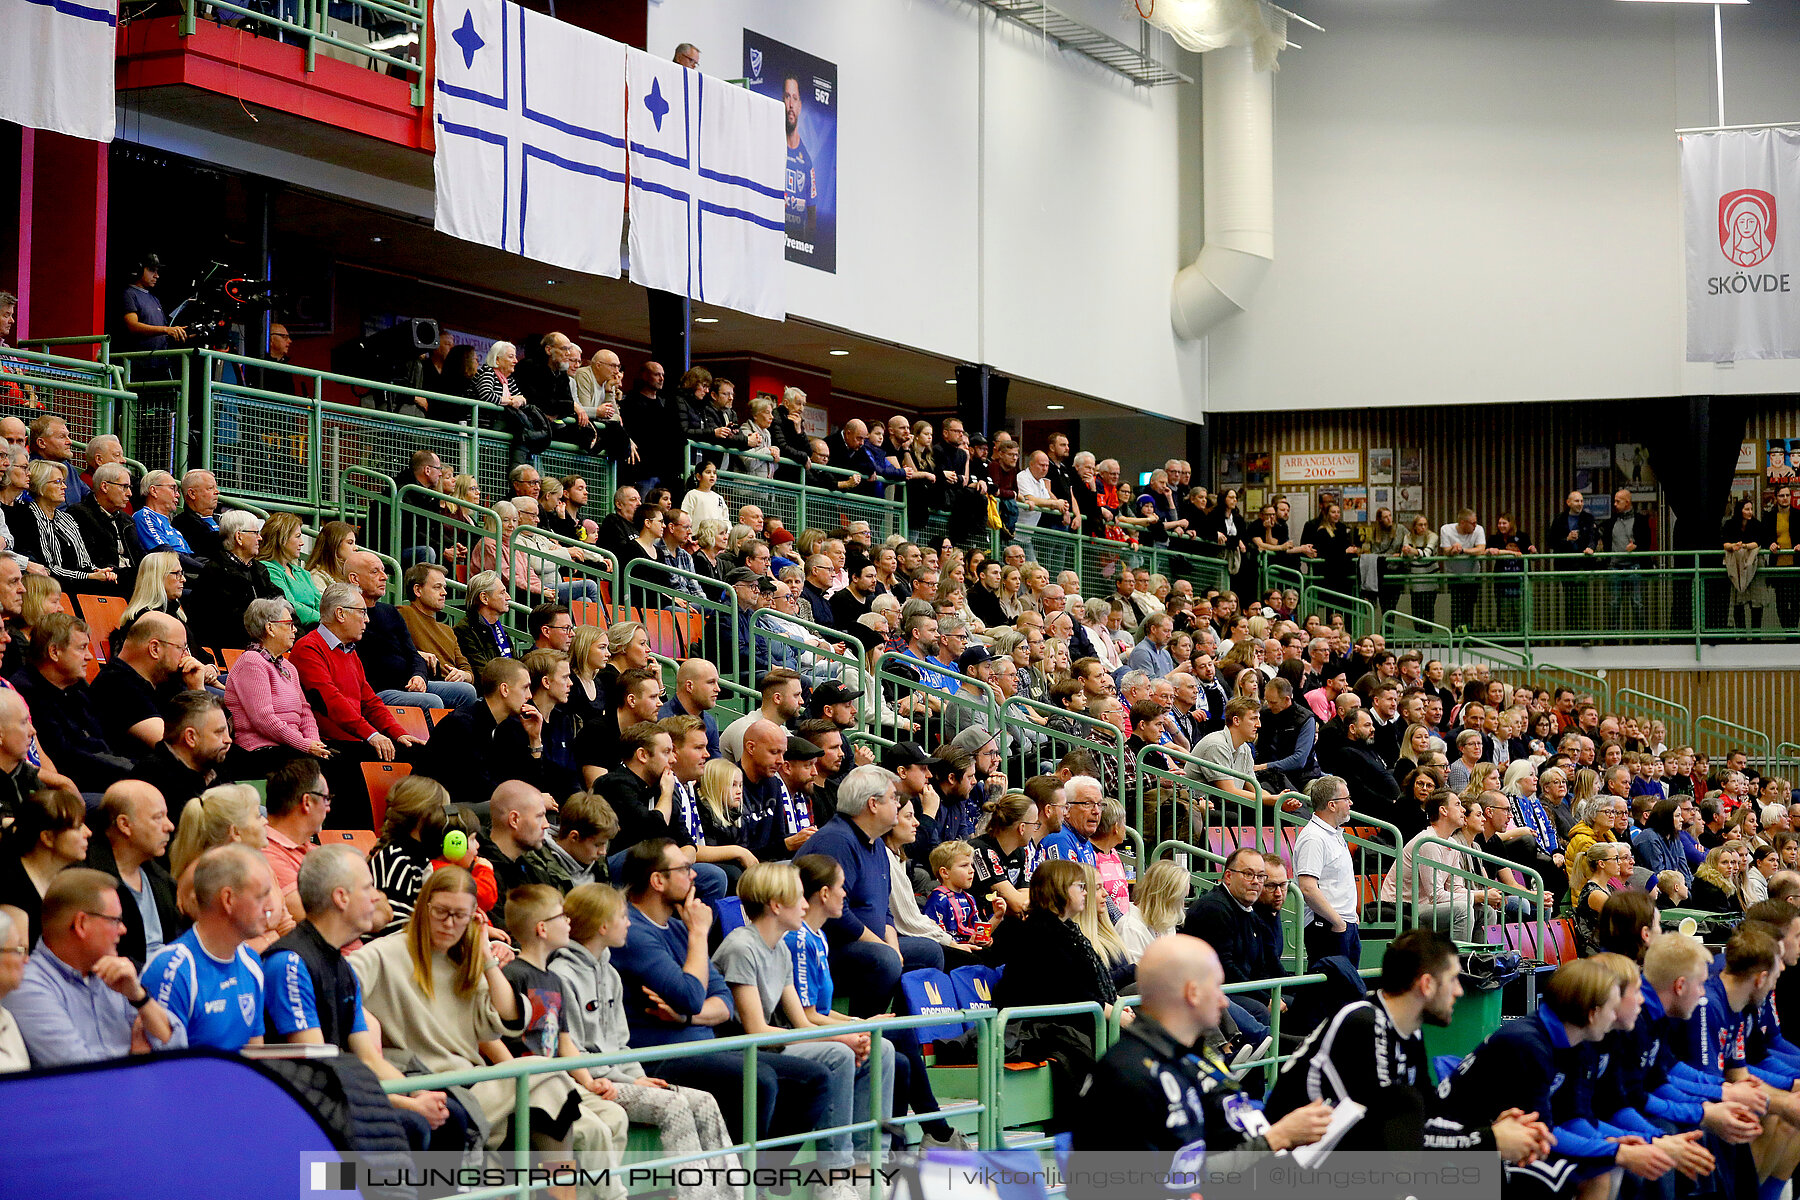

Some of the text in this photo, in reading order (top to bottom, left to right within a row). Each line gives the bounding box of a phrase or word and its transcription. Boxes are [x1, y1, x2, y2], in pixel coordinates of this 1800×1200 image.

[814, 88, 830, 105] 567
[1708, 271, 1790, 295] SKÖVDE
[1284, 455, 1355, 468] ARRANGEMANG
[1304, 467, 1336, 478] 2006
